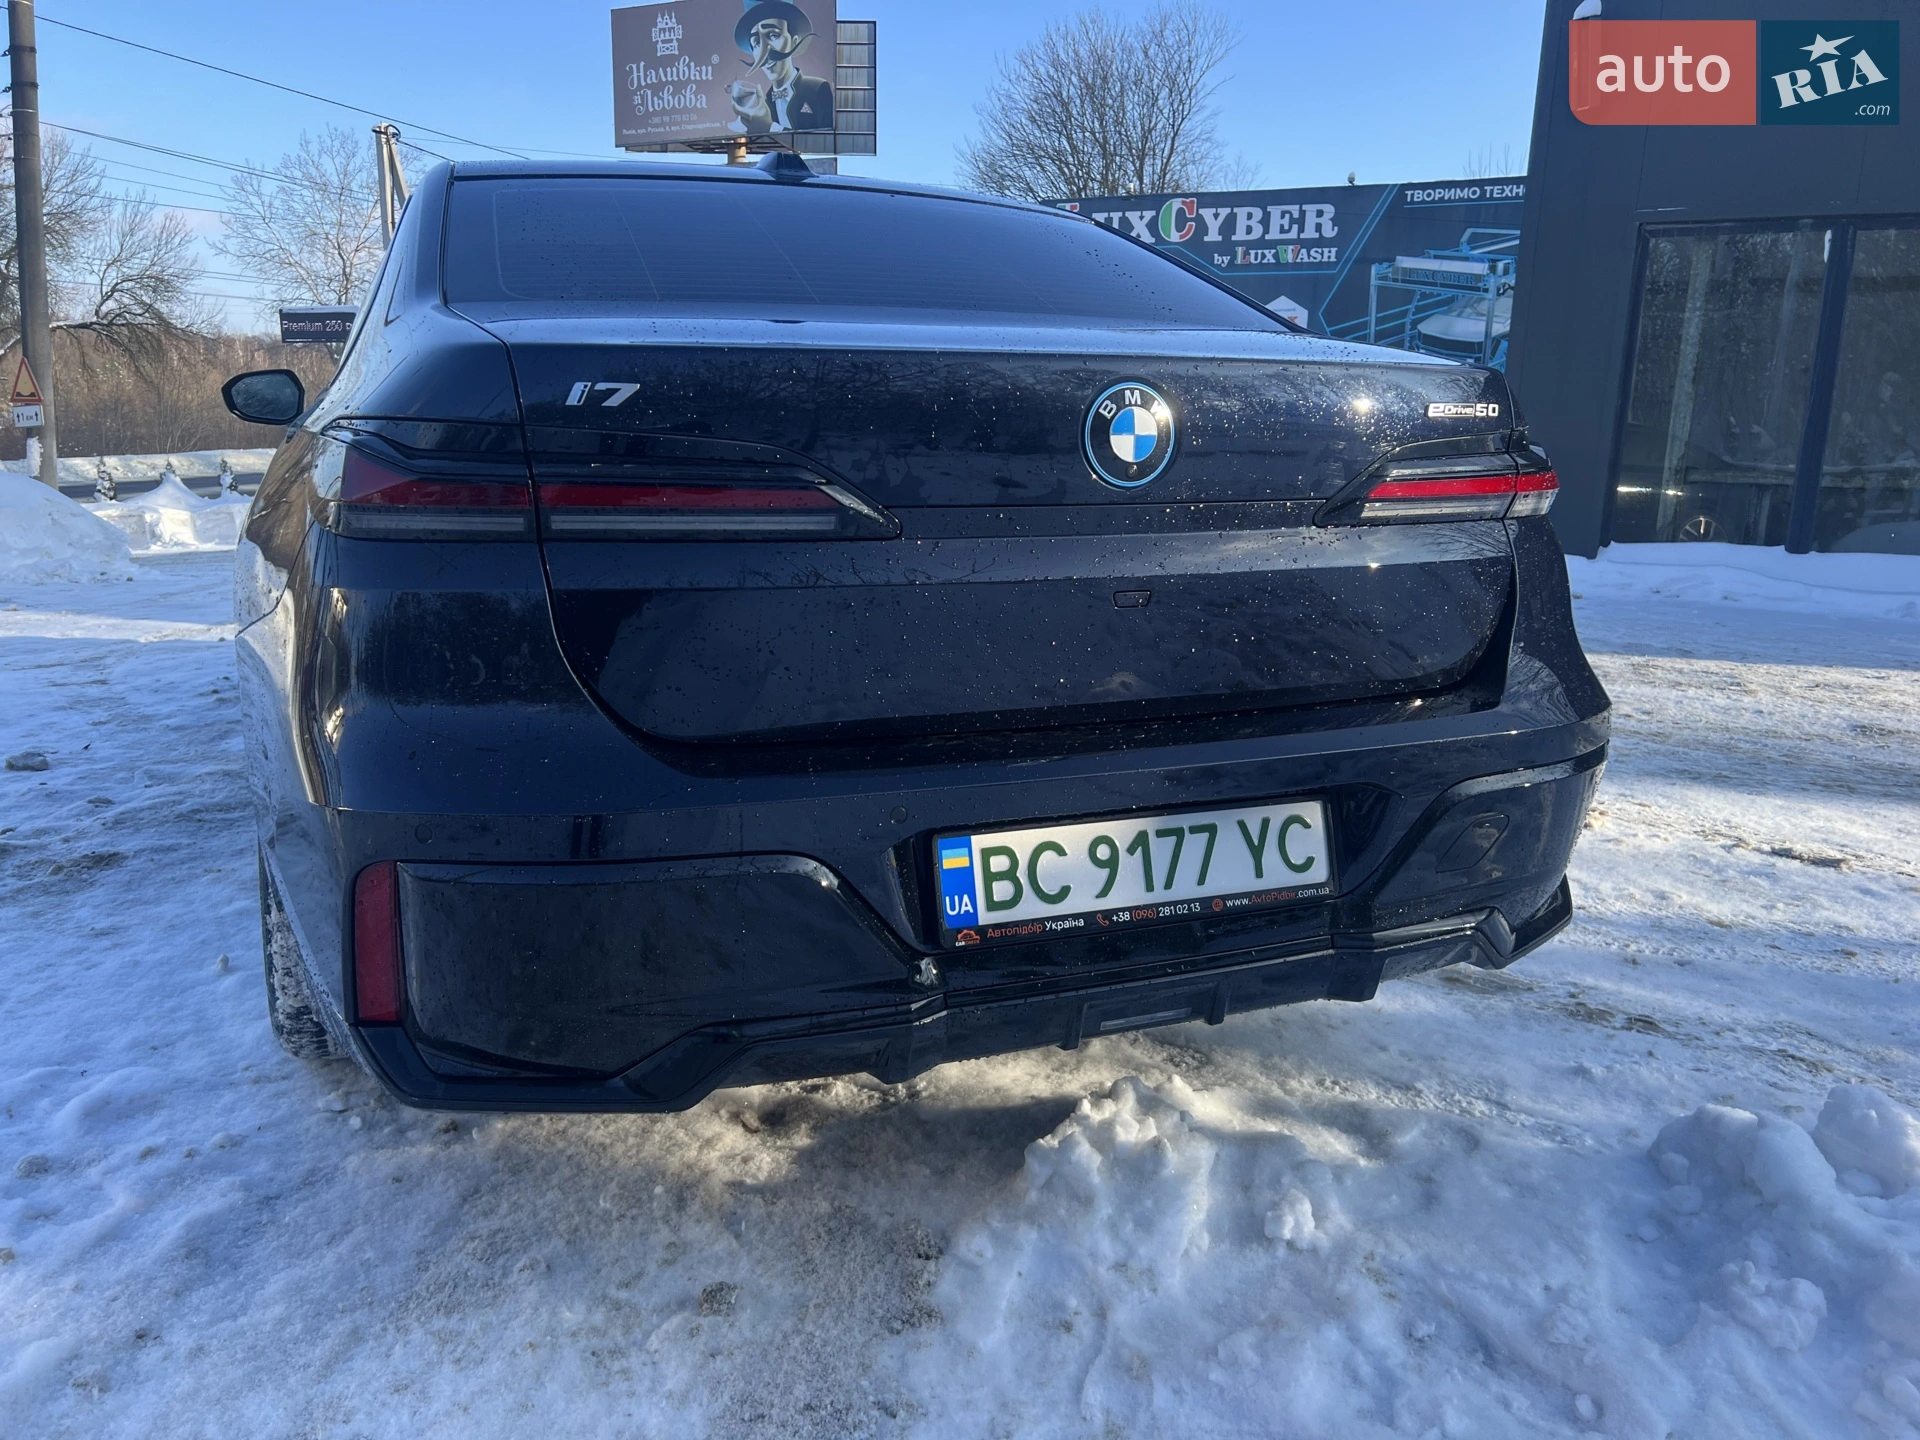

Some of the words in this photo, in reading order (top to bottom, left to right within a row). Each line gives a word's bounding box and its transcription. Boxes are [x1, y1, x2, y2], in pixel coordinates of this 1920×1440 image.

[626, 55, 713, 90] Наливки
[632, 91, 642, 105] зі
[635, 83, 708, 116] Львова
[1405, 187, 1480, 202] ТВОРИМО
[1056, 197, 1339, 243] XCYBER
[1213, 253, 1231, 267] by
[282, 320, 323, 332] Premium
[565, 382, 640, 406] i7
[1098, 389, 1170, 421] BMW
[980, 841, 1072, 912] BC
[1088, 821, 1218, 899] 9177
[1237, 813, 1316, 879] YC
[945, 894, 974, 915] UA
[1225, 886, 1330, 907] www.AvtoPidbir.com.ua
[1111, 911, 1130, 922] +38
[1132, 908, 1157, 921] (096)
[1158, 905, 1176, 917] 281
[1176, 904, 1189, 915] 02
[1190, 902, 1201, 913] 13
[987, 922, 1043, 938] Автопідбір
[1044, 917, 1084, 931] Україна
